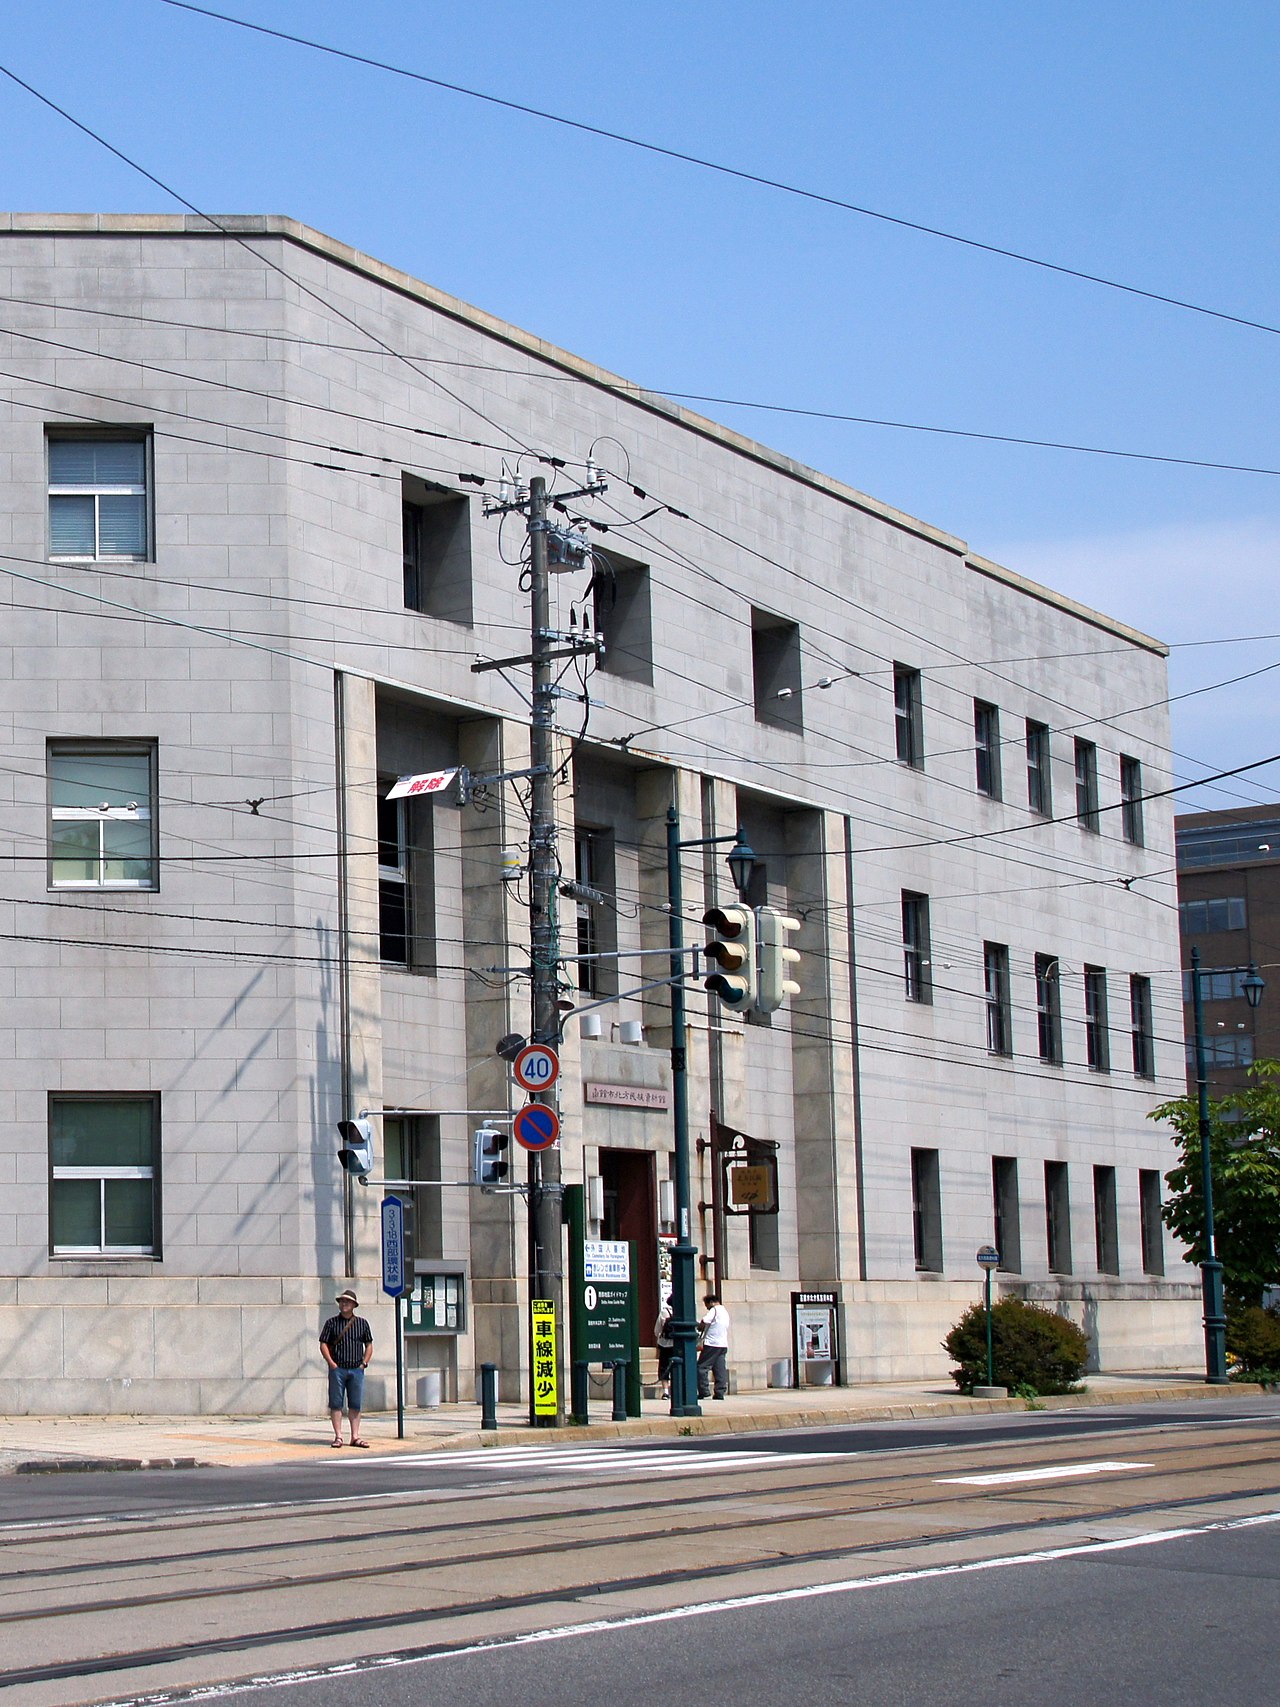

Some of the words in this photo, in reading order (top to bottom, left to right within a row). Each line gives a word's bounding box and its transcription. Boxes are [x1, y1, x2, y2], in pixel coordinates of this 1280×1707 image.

[407, 777, 445, 794] 解除
[524, 1058, 549, 1079] 40
[536, 1321, 553, 1398] 車線減少
